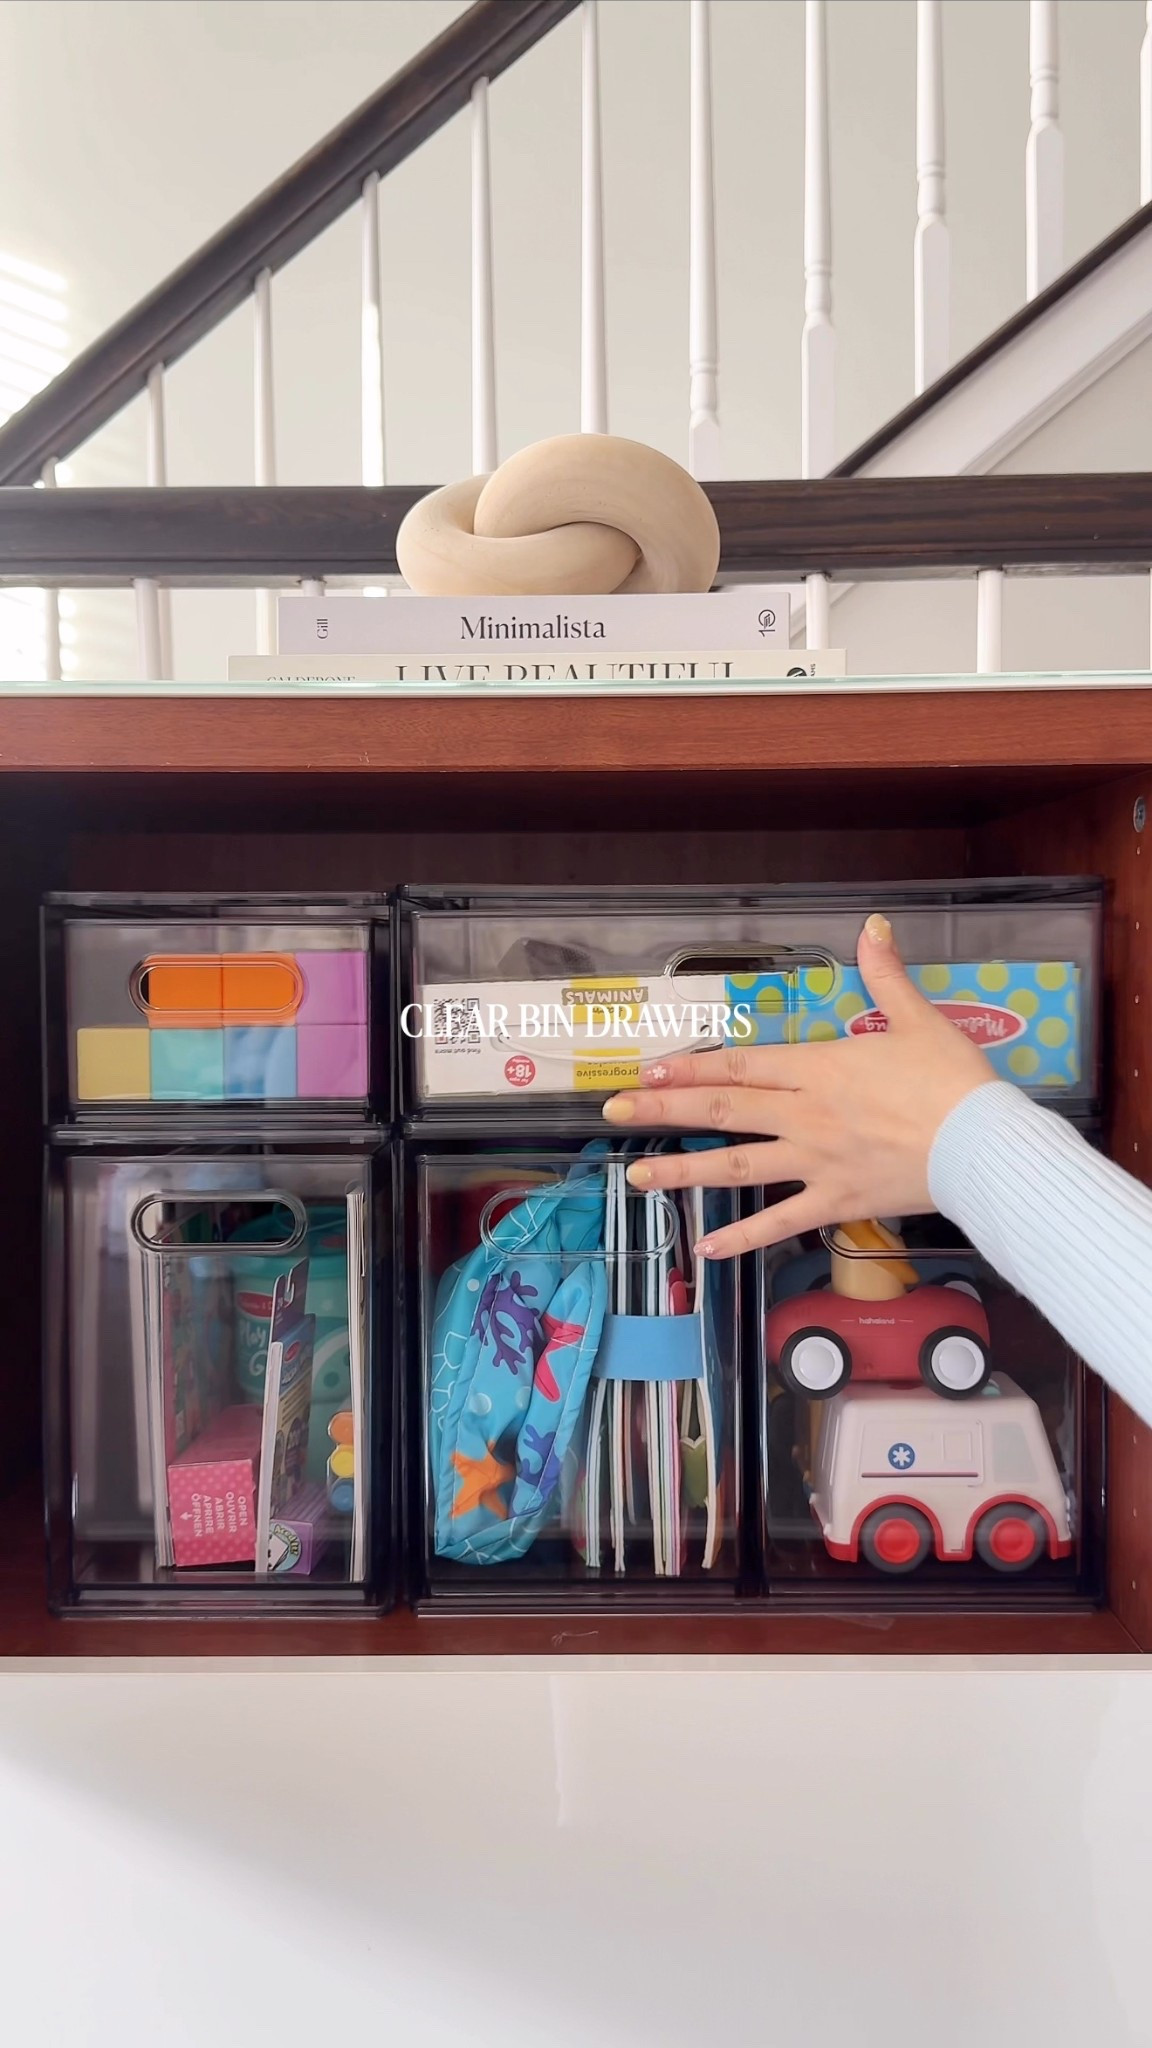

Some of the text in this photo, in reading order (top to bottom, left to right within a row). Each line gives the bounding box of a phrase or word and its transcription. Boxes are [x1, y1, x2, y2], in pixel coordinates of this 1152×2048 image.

[316, 618, 329, 640] Gill
[460, 615, 606, 640] Minimalista
[566, 988, 644, 1005] ANIMALS
[507, 1063, 533, 1077] 18+
[576, 1066, 640, 1080] progressive
[190, 1492, 203, 1538] ÖFFNEN
[202, 1494, 215, 1535] APRIRE
[214, 1497, 225, 1531] ABRIR
[225, 1491, 238, 1533] OUVRIR
[237, 1495, 248, 1527] OPEN
